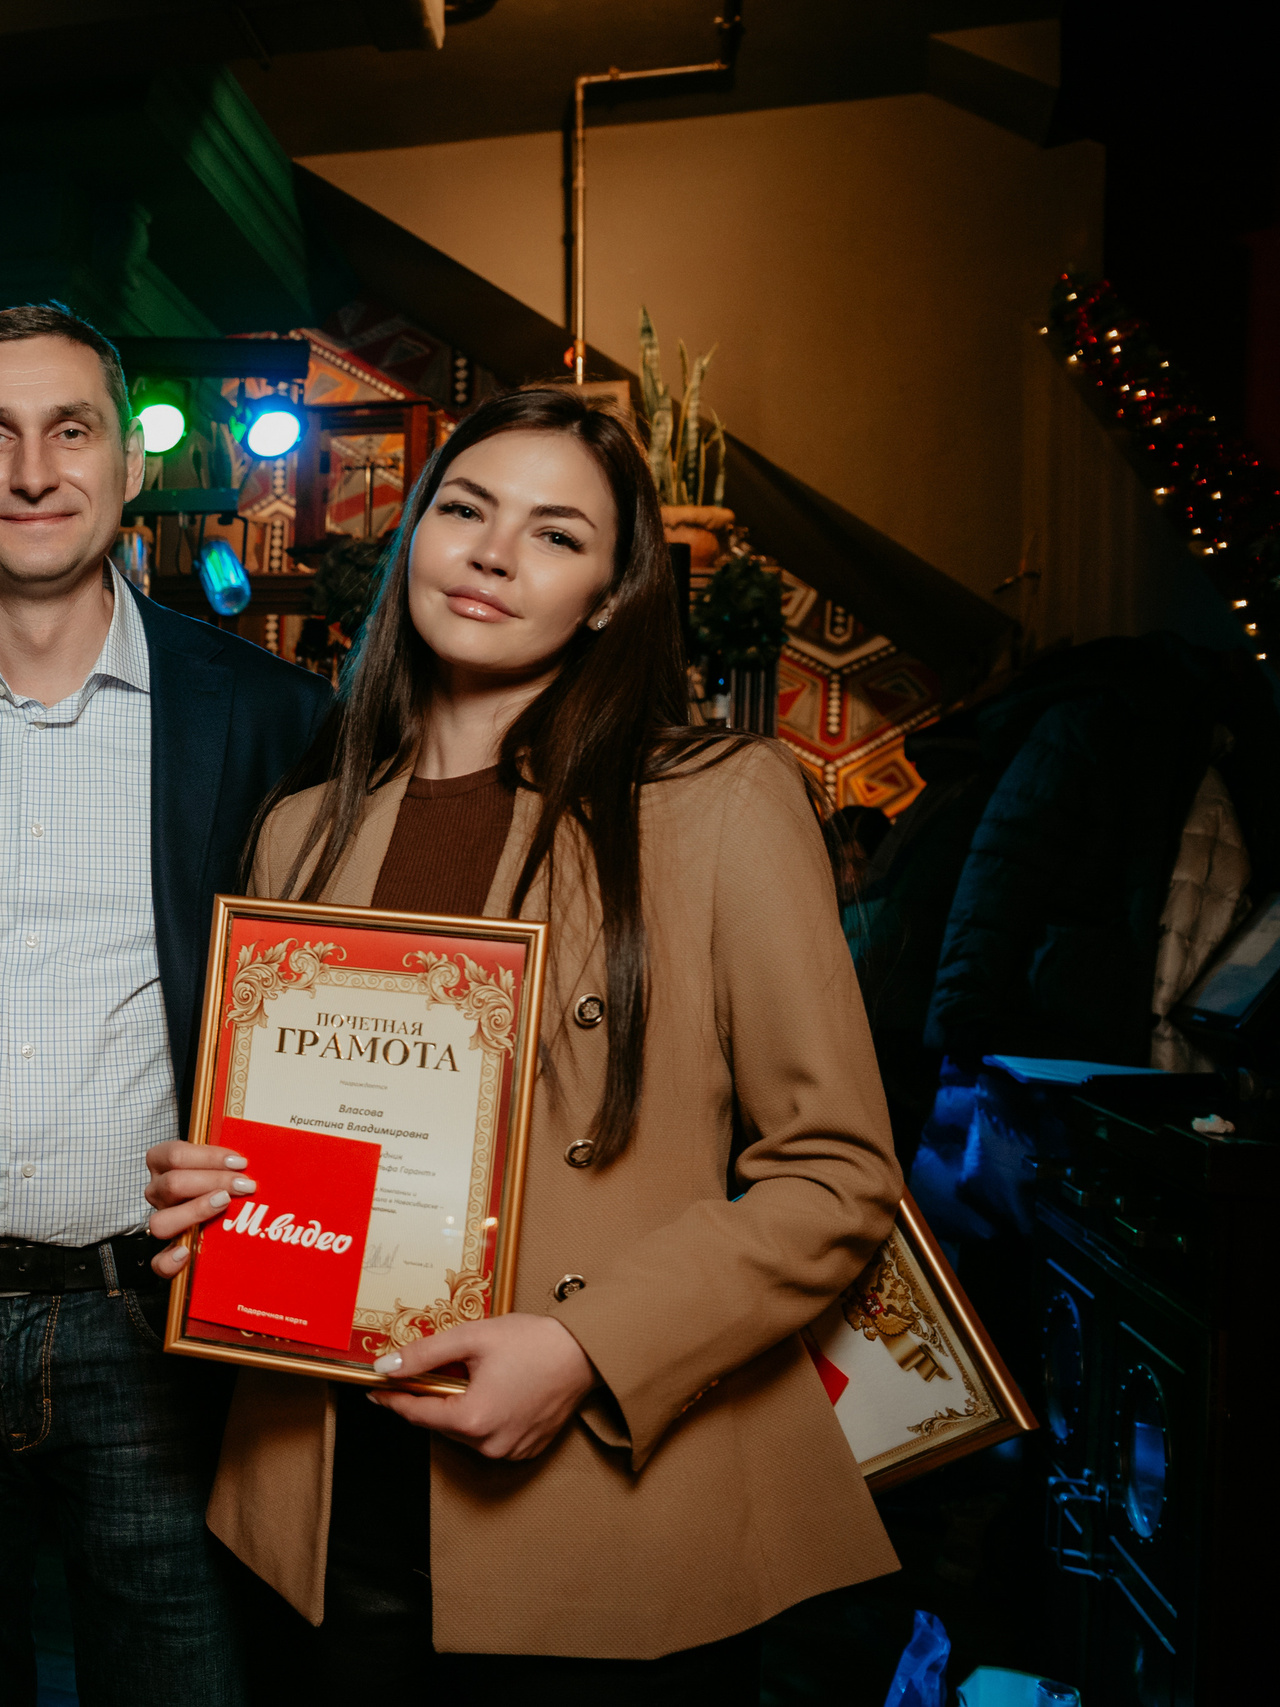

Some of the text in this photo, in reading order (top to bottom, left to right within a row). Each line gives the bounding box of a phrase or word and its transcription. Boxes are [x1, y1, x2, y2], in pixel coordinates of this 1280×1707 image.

[316, 1012, 423, 1036] ПОЧЕТНАЯ
[275, 1026, 460, 1072] ГРАМОТА
[338, 1103, 384, 1118] Власова
[289, 1115, 429, 1140] Кристина Владимировна
[222, 1201, 353, 1254] М.видео
[237, 1304, 308, 1326] Подарочная карта
